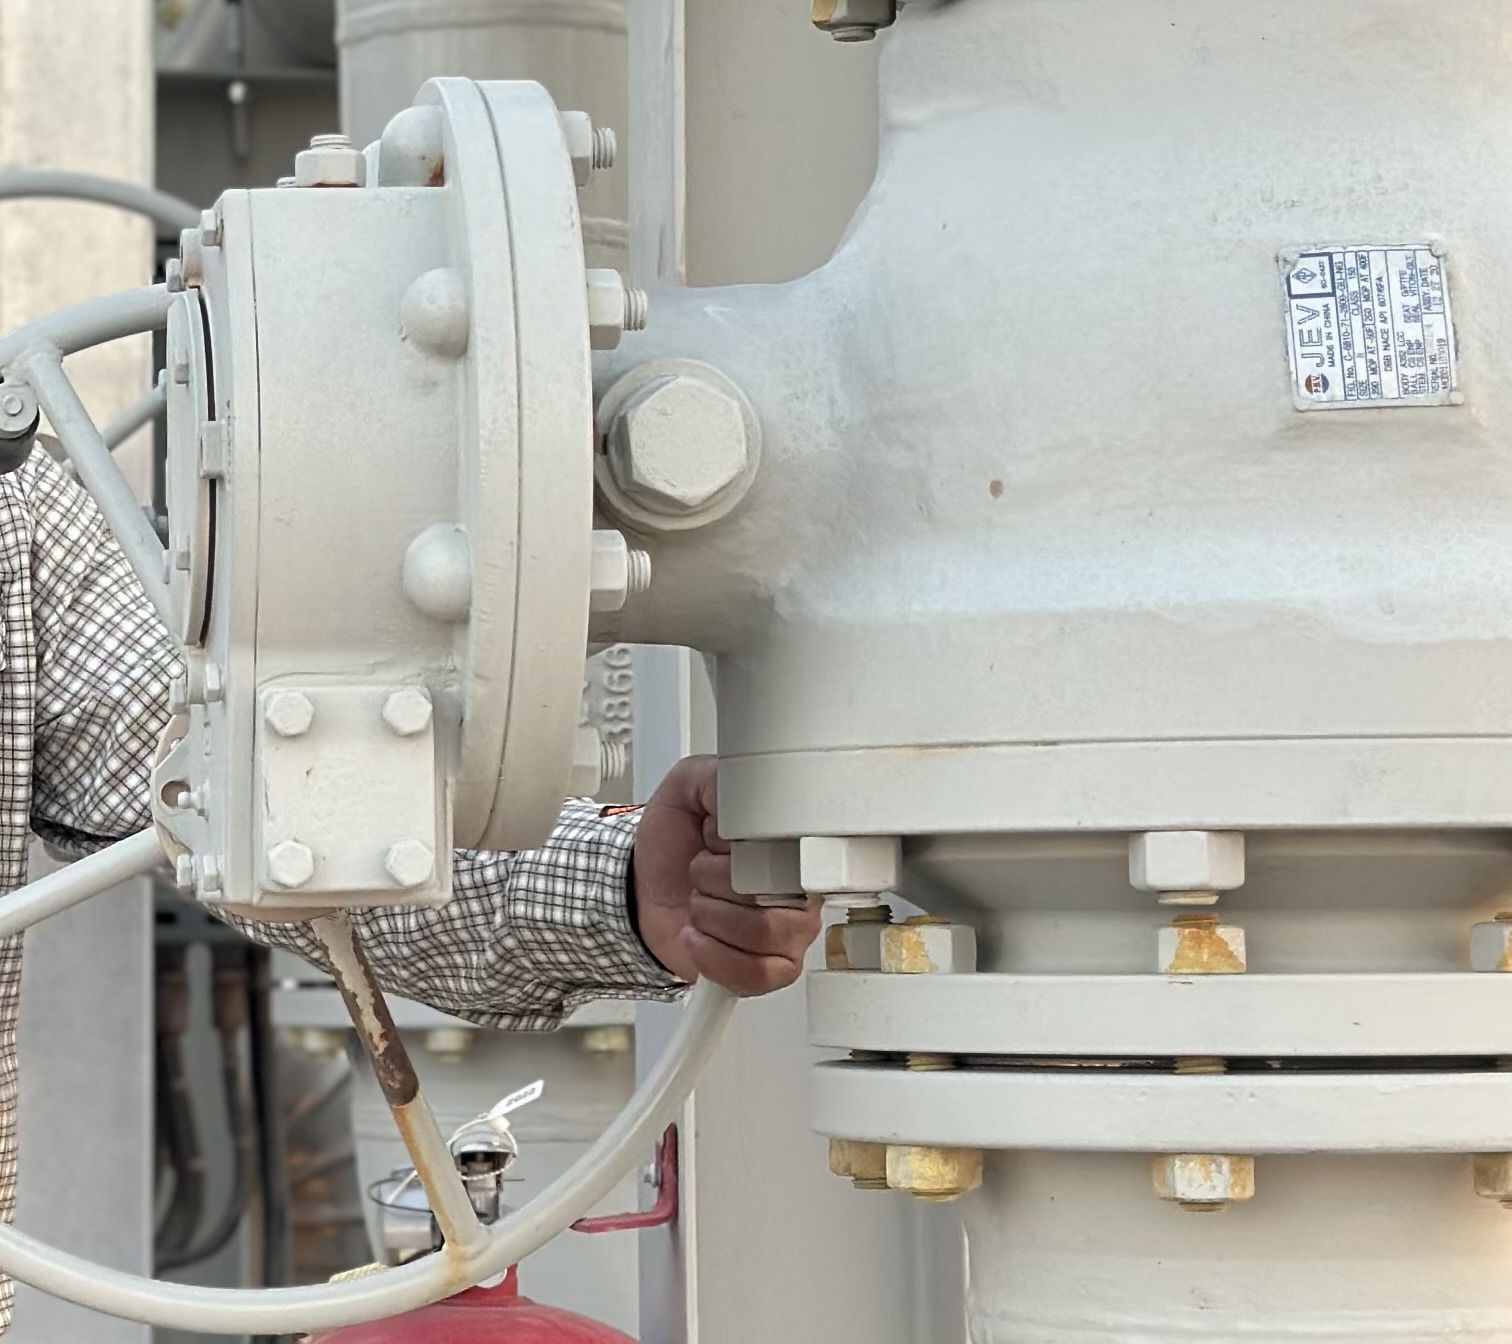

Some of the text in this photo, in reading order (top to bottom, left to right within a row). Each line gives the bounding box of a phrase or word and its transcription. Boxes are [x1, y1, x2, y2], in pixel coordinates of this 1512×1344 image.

[1347, 268, 1356, 278] 150
[1360, 273, 1368, 282] AT
[1361, 286, 1370, 301] MOP
[1350, 291, 1360, 316] CLASS
[1322, 304, 1331, 328] CHINA
[1379, 312, 1387, 324] API
[1296, 304, 1324, 367] JEV
[1380, 328, 1390, 350] NACE
[1326, 345, 1335, 367] MADE
[1367, 346, 1376, 354] AT
[1368, 359, 1377, 375] MOP
[1358, 380, 1367, 396] SIZE
[1401, 374, 1409, 394] BODY
